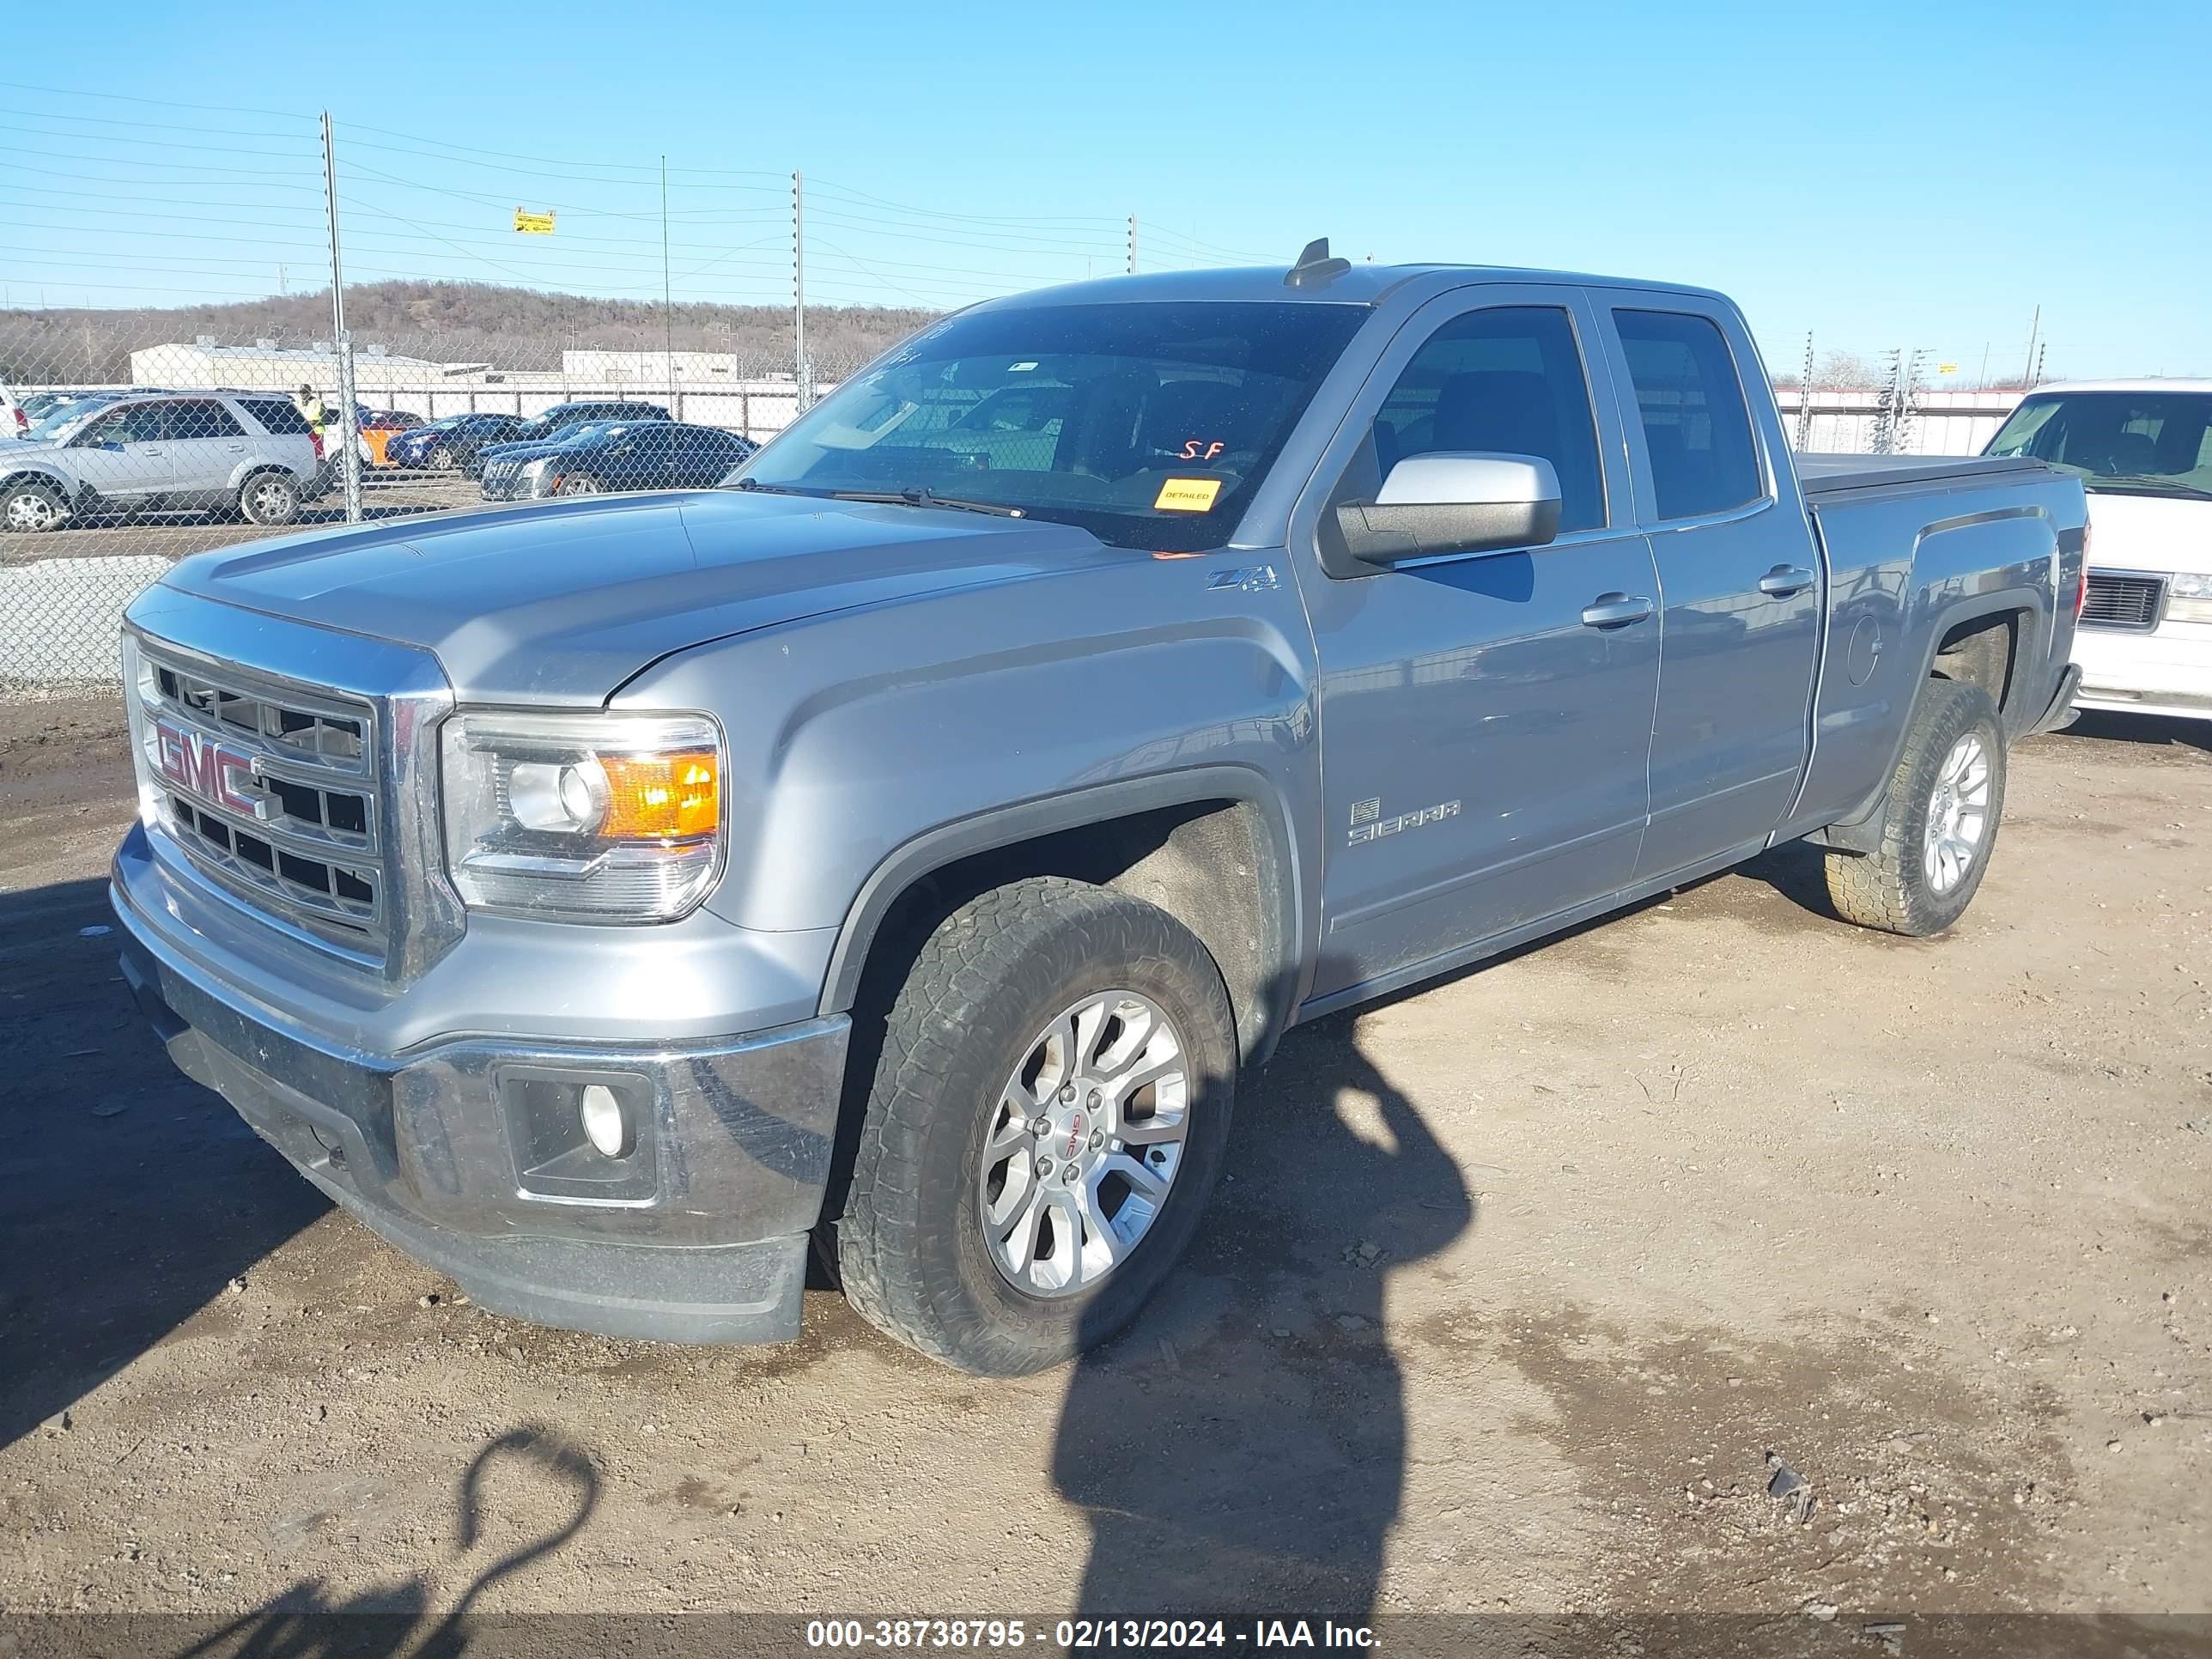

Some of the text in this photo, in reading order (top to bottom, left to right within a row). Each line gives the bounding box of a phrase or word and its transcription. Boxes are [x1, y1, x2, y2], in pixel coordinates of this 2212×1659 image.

[1165, 491, 1210, 500] DETAILED
[157, 719, 280, 821] GMC
[1347, 799, 1462, 847] SIERRA
[1066, 1114, 1080, 1157] GMC
